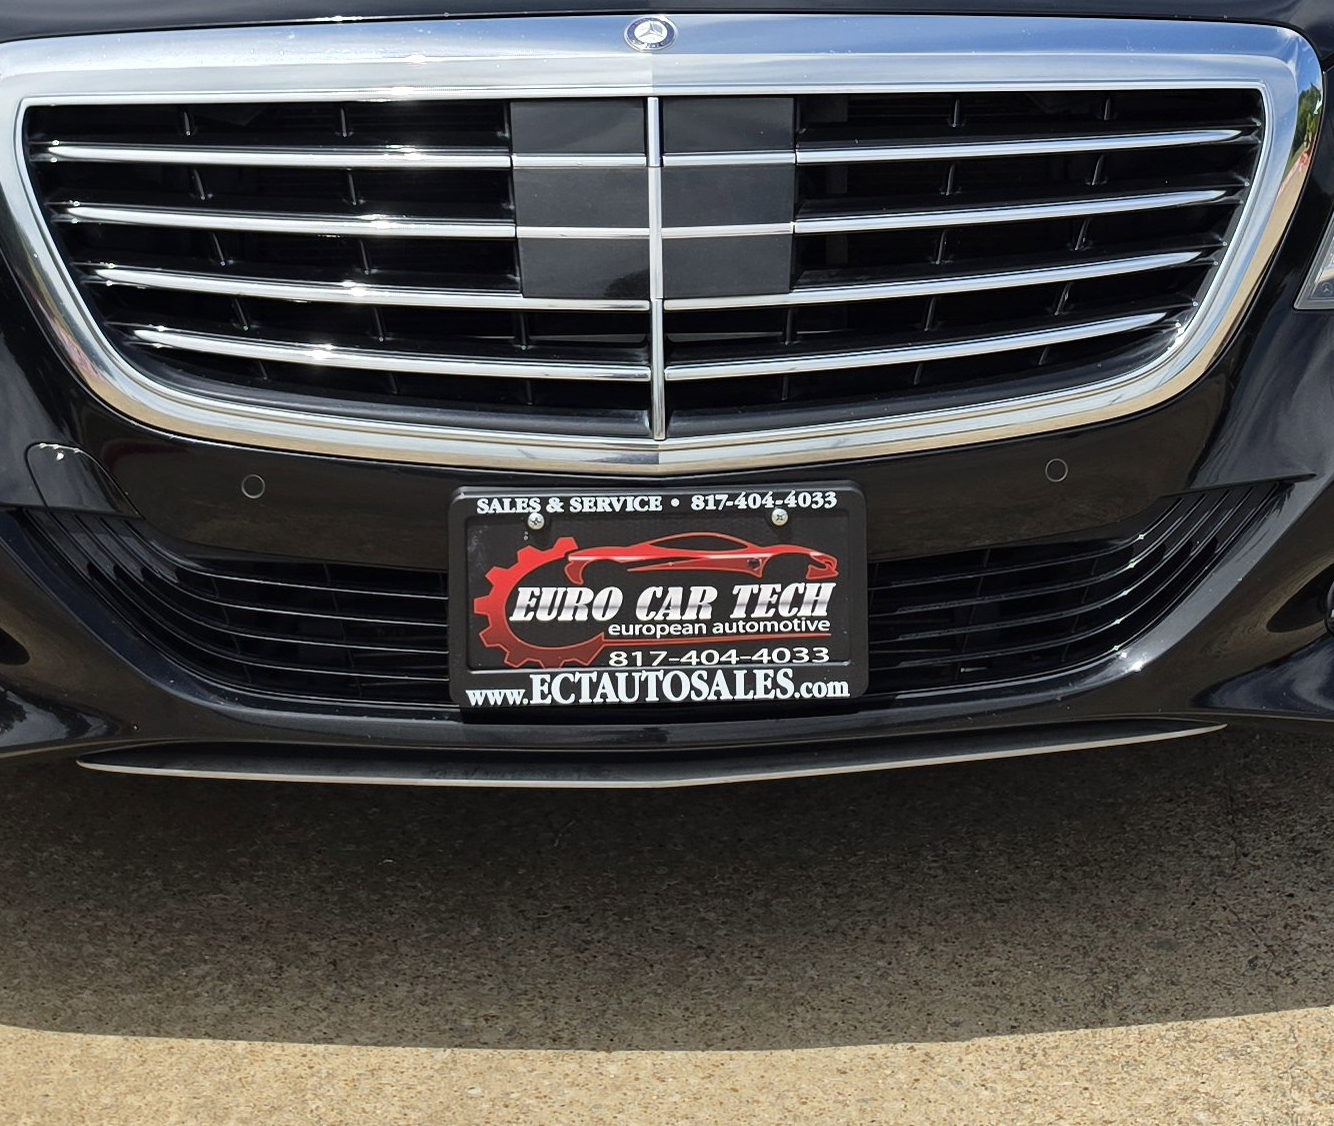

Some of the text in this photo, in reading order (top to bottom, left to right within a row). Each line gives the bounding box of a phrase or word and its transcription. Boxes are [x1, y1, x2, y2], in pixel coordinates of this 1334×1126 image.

[476, 491, 838, 514] SALES & SERVICE 817-404-4033
[509, 582, 837, 622] EURO CAR TECH
[608, 617, 831, 639] european automotive
[608, 646, 830, 667] 817-404-4033
[466, 669, 851, 706] www.ECTAUTOSALES.com
